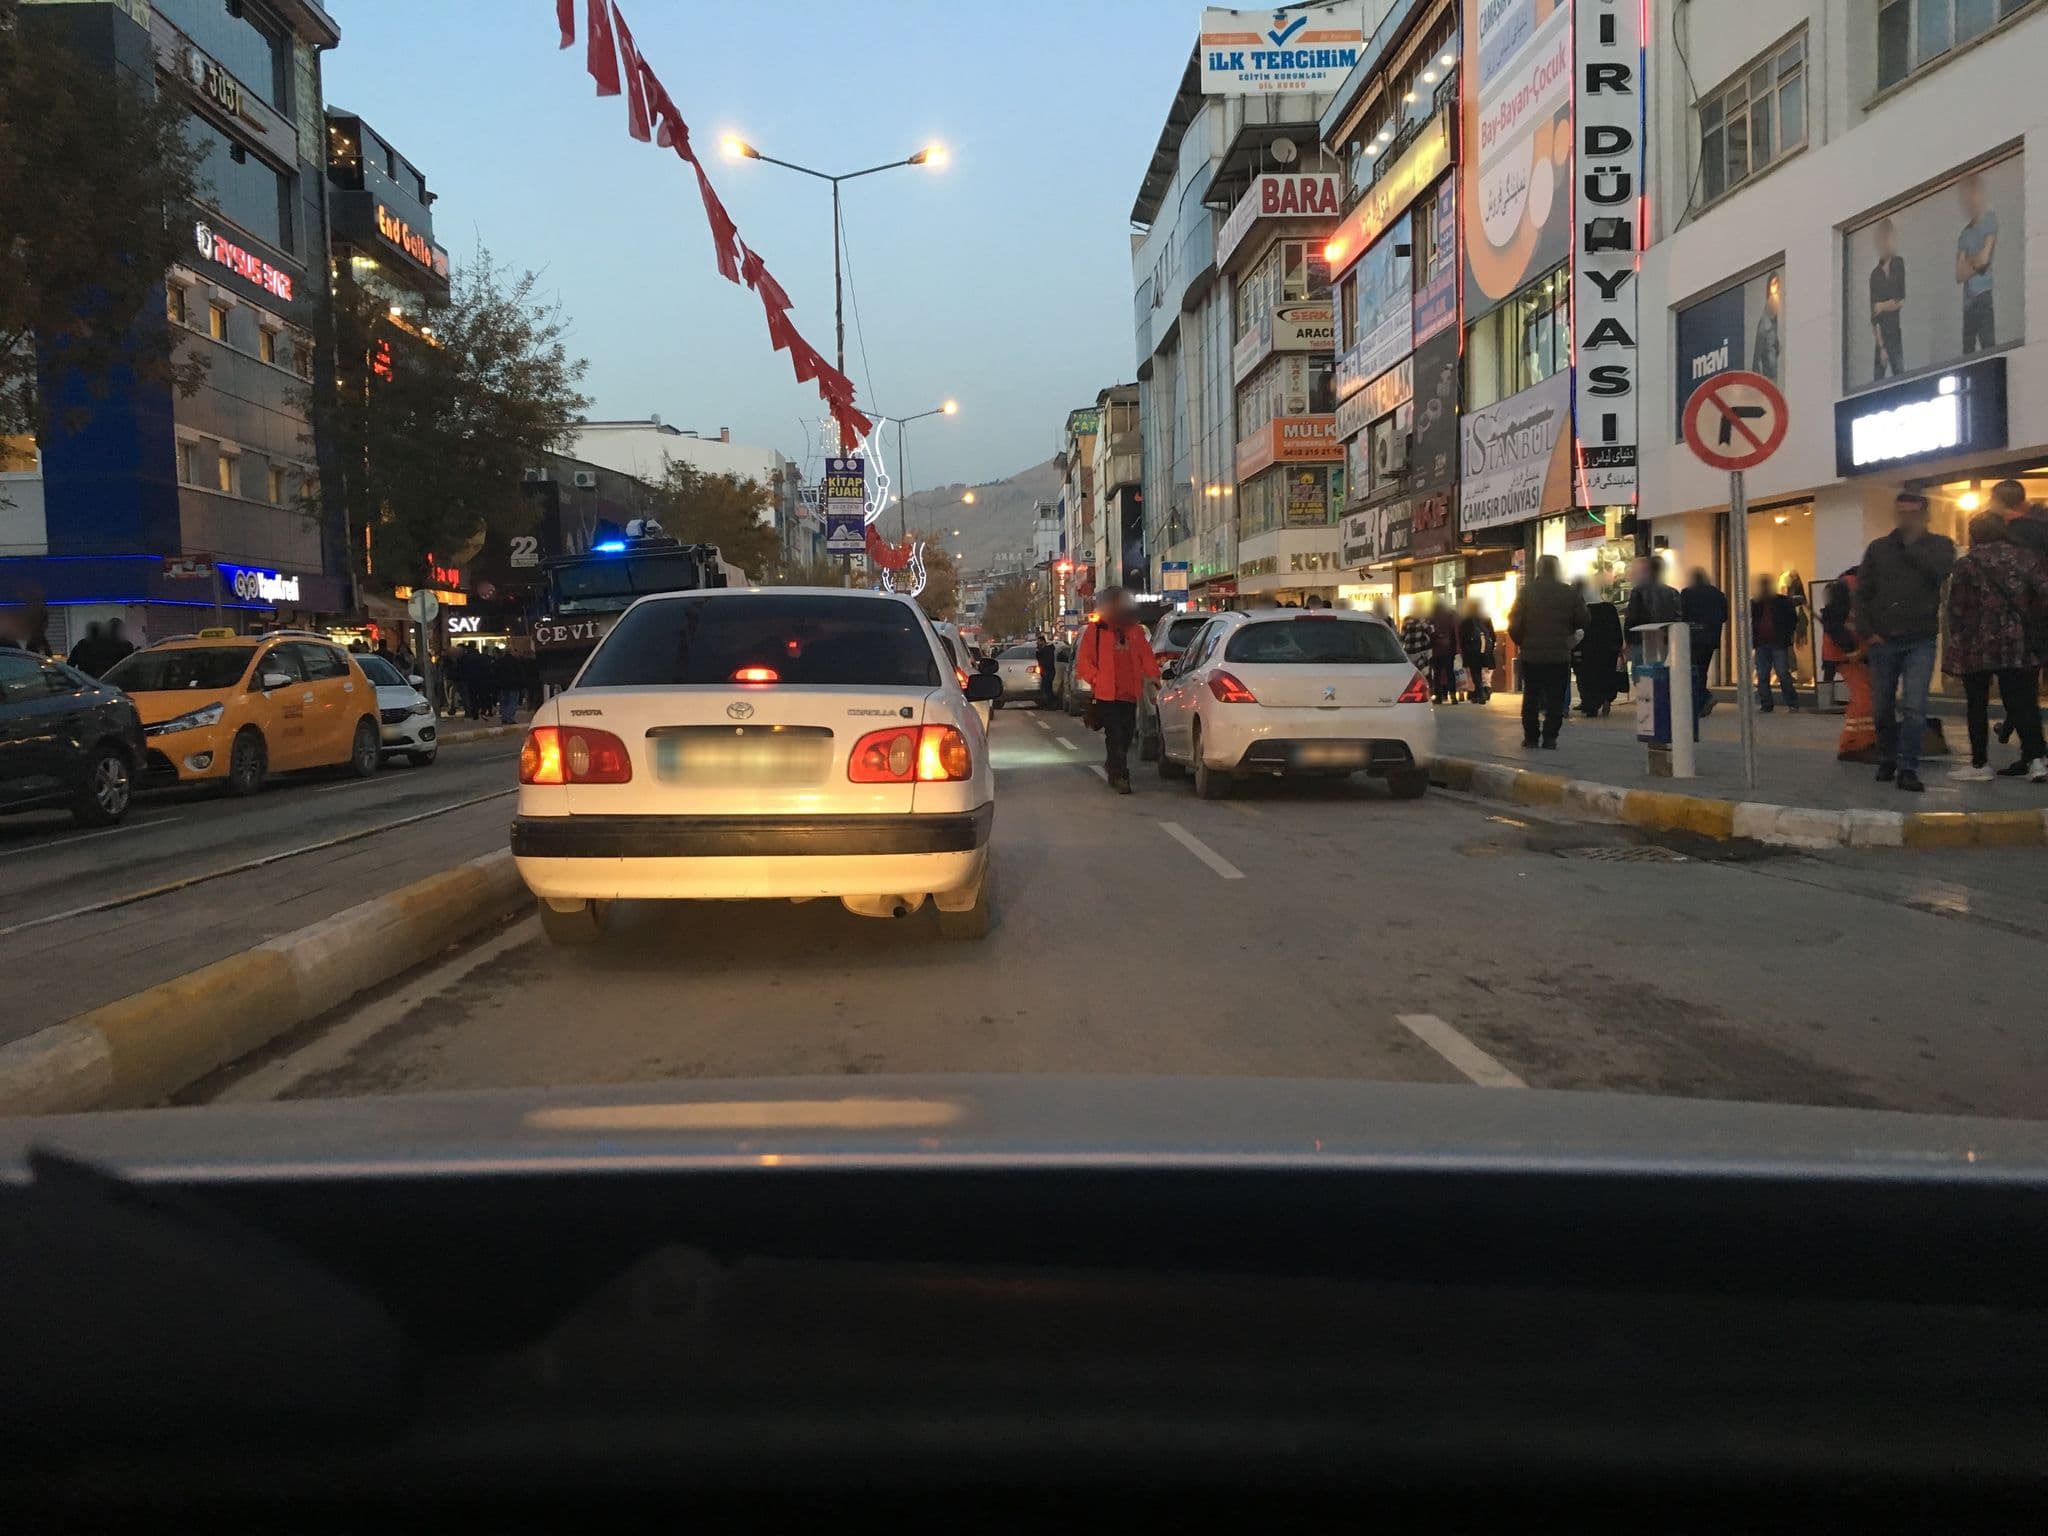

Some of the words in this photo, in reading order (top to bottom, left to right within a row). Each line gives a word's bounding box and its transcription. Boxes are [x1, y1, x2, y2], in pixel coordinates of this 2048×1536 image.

[1262, 177, 1338, 214] BARA
[1692, 338, 1729, 380] mavi
[829, 475, 863, 487] KİTAP
[829, 488, 863, 497] FUARI
[1463, 497, 1500, 530] ÇAMAŞIR
[1501, 486, 1540, 517] DÜNYASI
[510, 536, 538, 559] 22
[448, 617, 480, 632] SAY
[570, 709, 603, 717] TOYOTA
